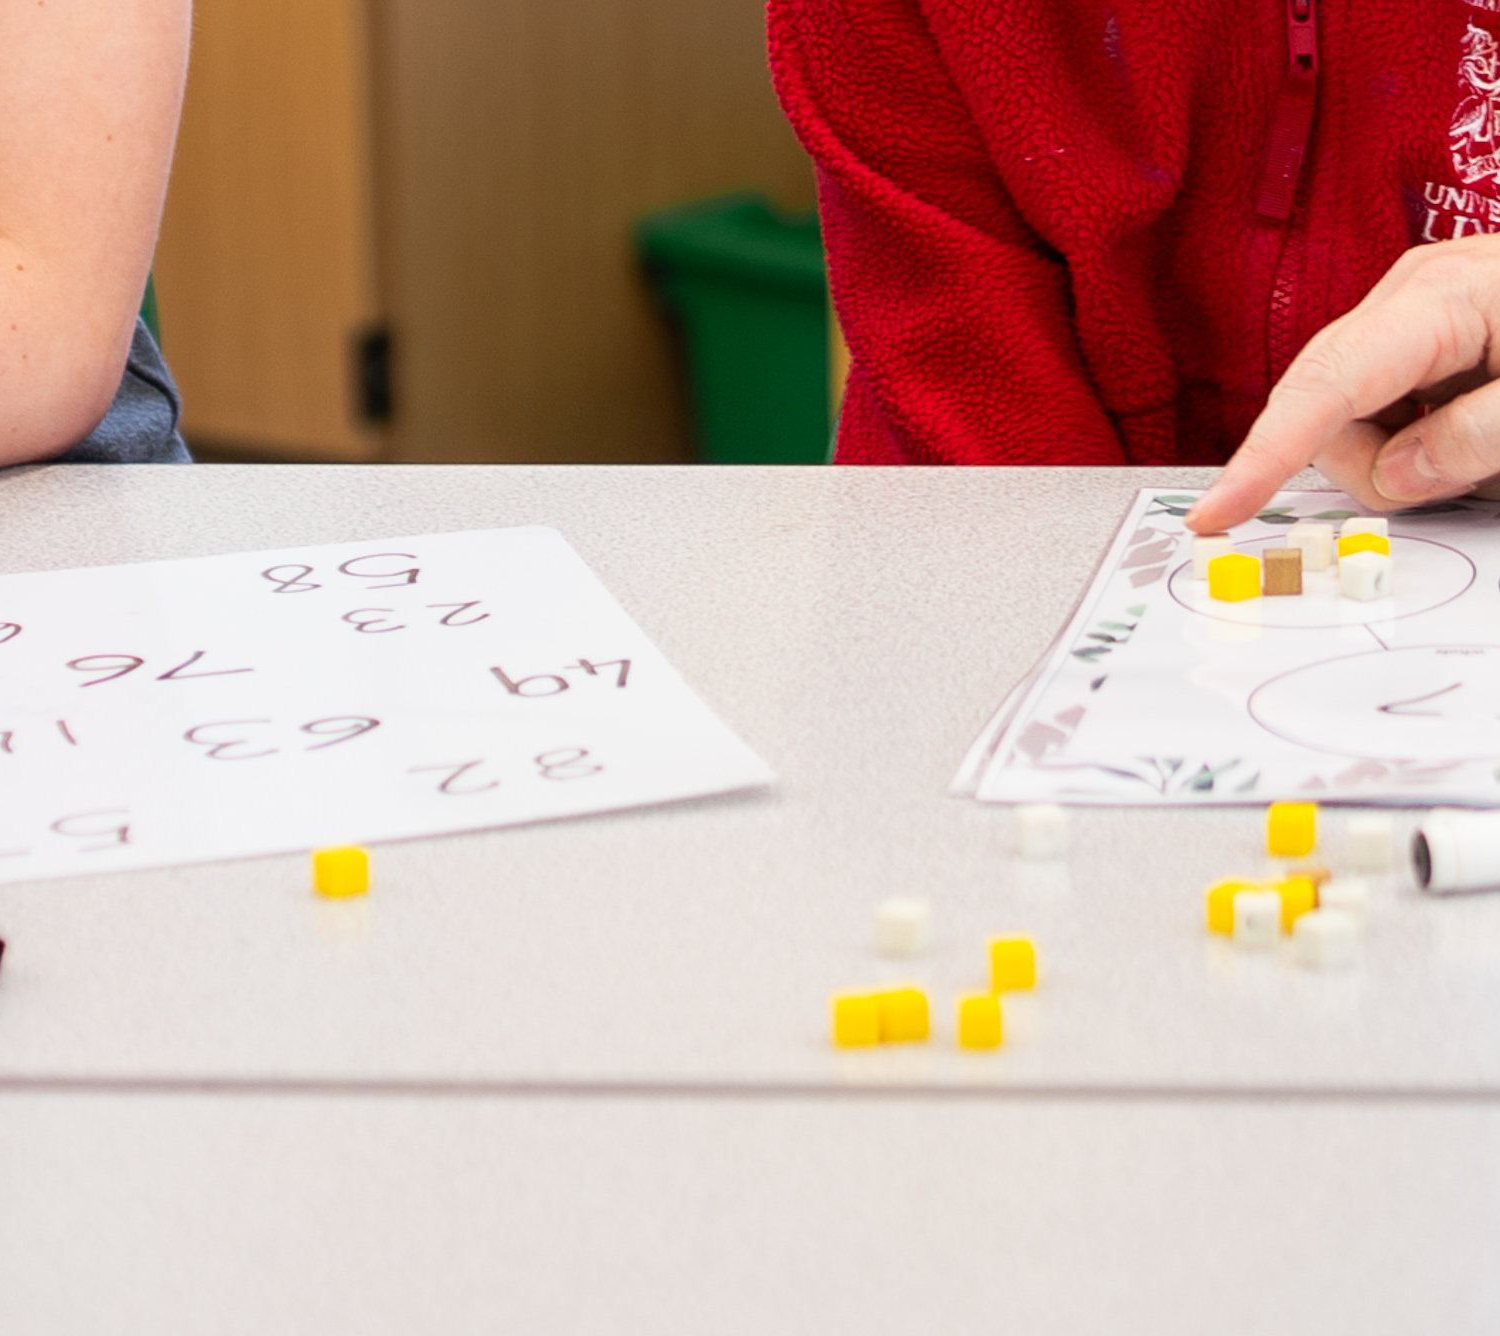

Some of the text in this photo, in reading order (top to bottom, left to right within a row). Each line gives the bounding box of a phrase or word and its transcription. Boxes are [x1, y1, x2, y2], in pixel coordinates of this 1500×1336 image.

[260, 553, 422, 594] 58
[341, 600, 491, 635] 23
[64, 649, 255, 689] 76
[488, 656, 633, 700] 49
[182, 715, 383, 760] 63
[408, 747, 605, 796] 82
